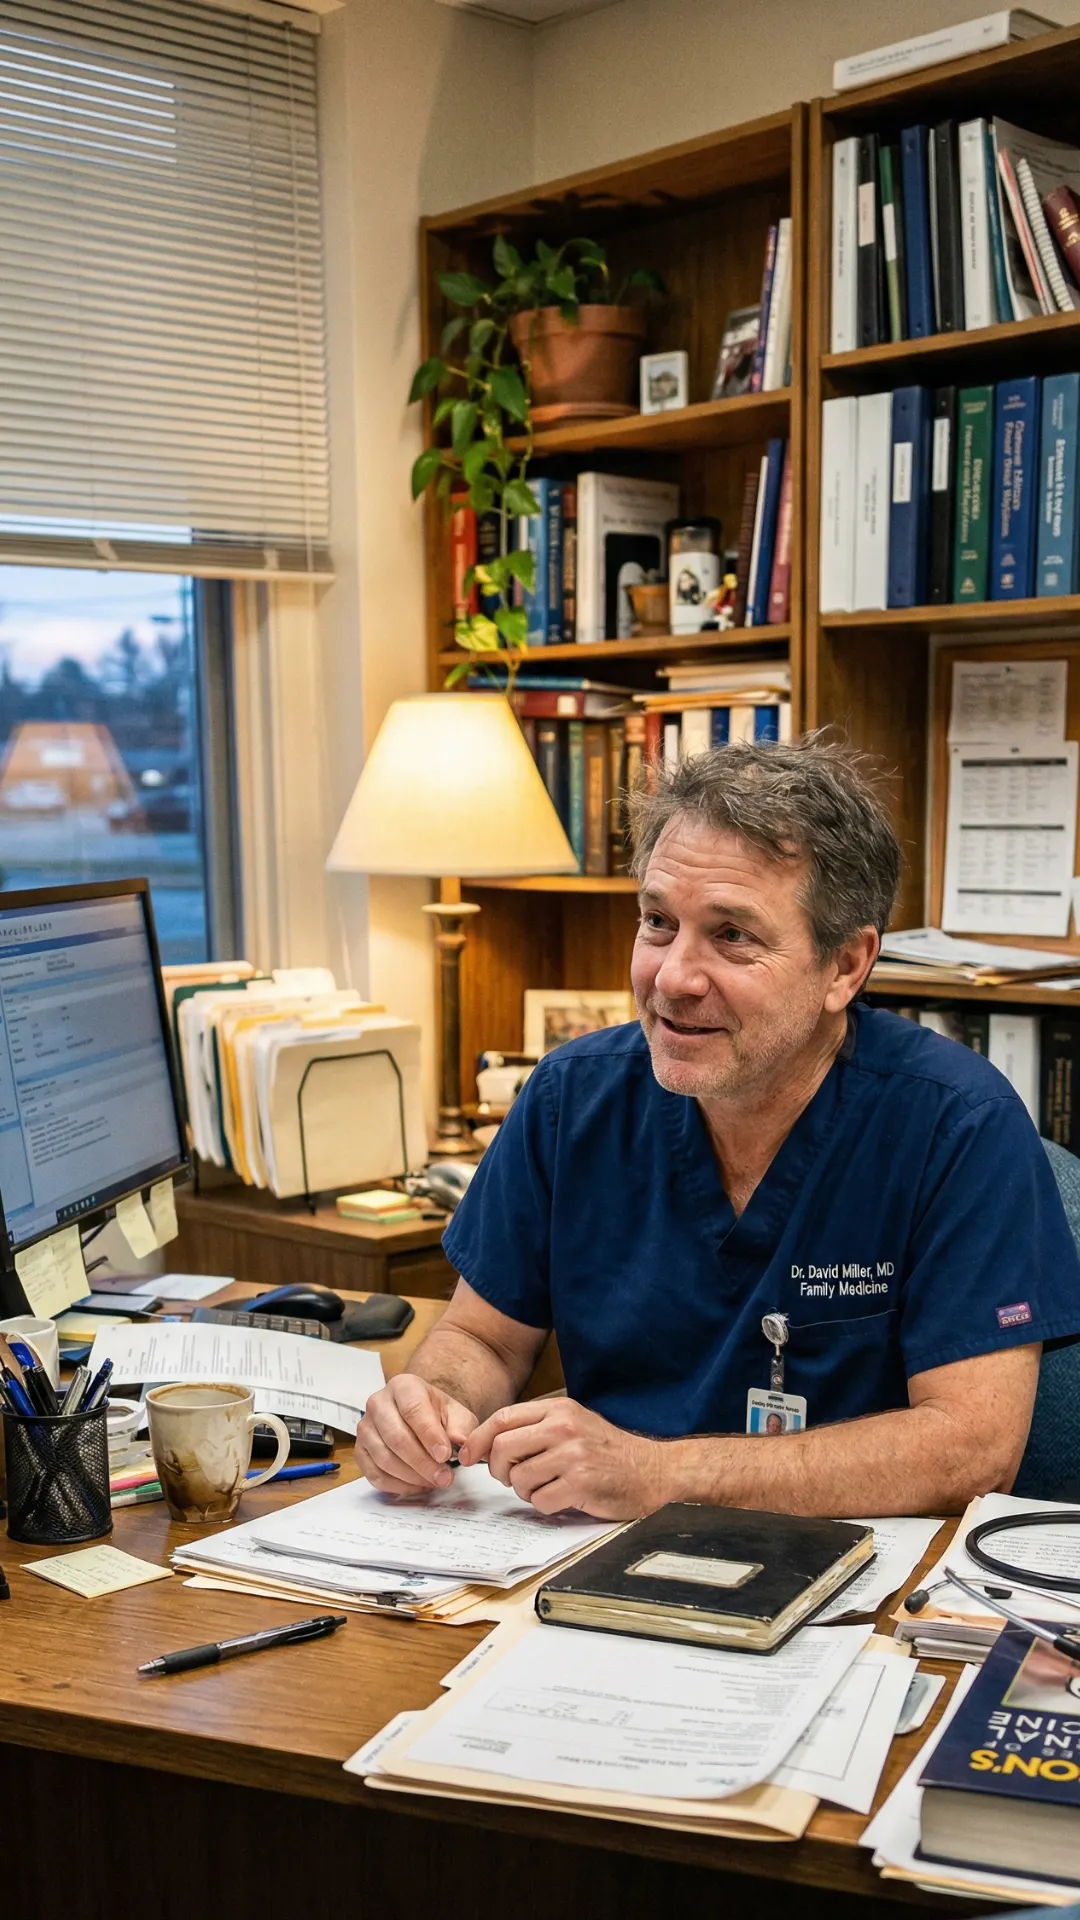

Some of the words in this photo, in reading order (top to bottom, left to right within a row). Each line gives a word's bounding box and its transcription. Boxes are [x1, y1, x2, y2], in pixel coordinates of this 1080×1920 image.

[791, 1265, 805, 1279] Dr.
[808, 1264, 839, 1279] David
[842, 1263, 872, 1280] Miller,
[876, 1262, 895, 1277] MD
[800, 1281, 835, 1299] Family
[987, 1725, 1080, 1749] NAL
